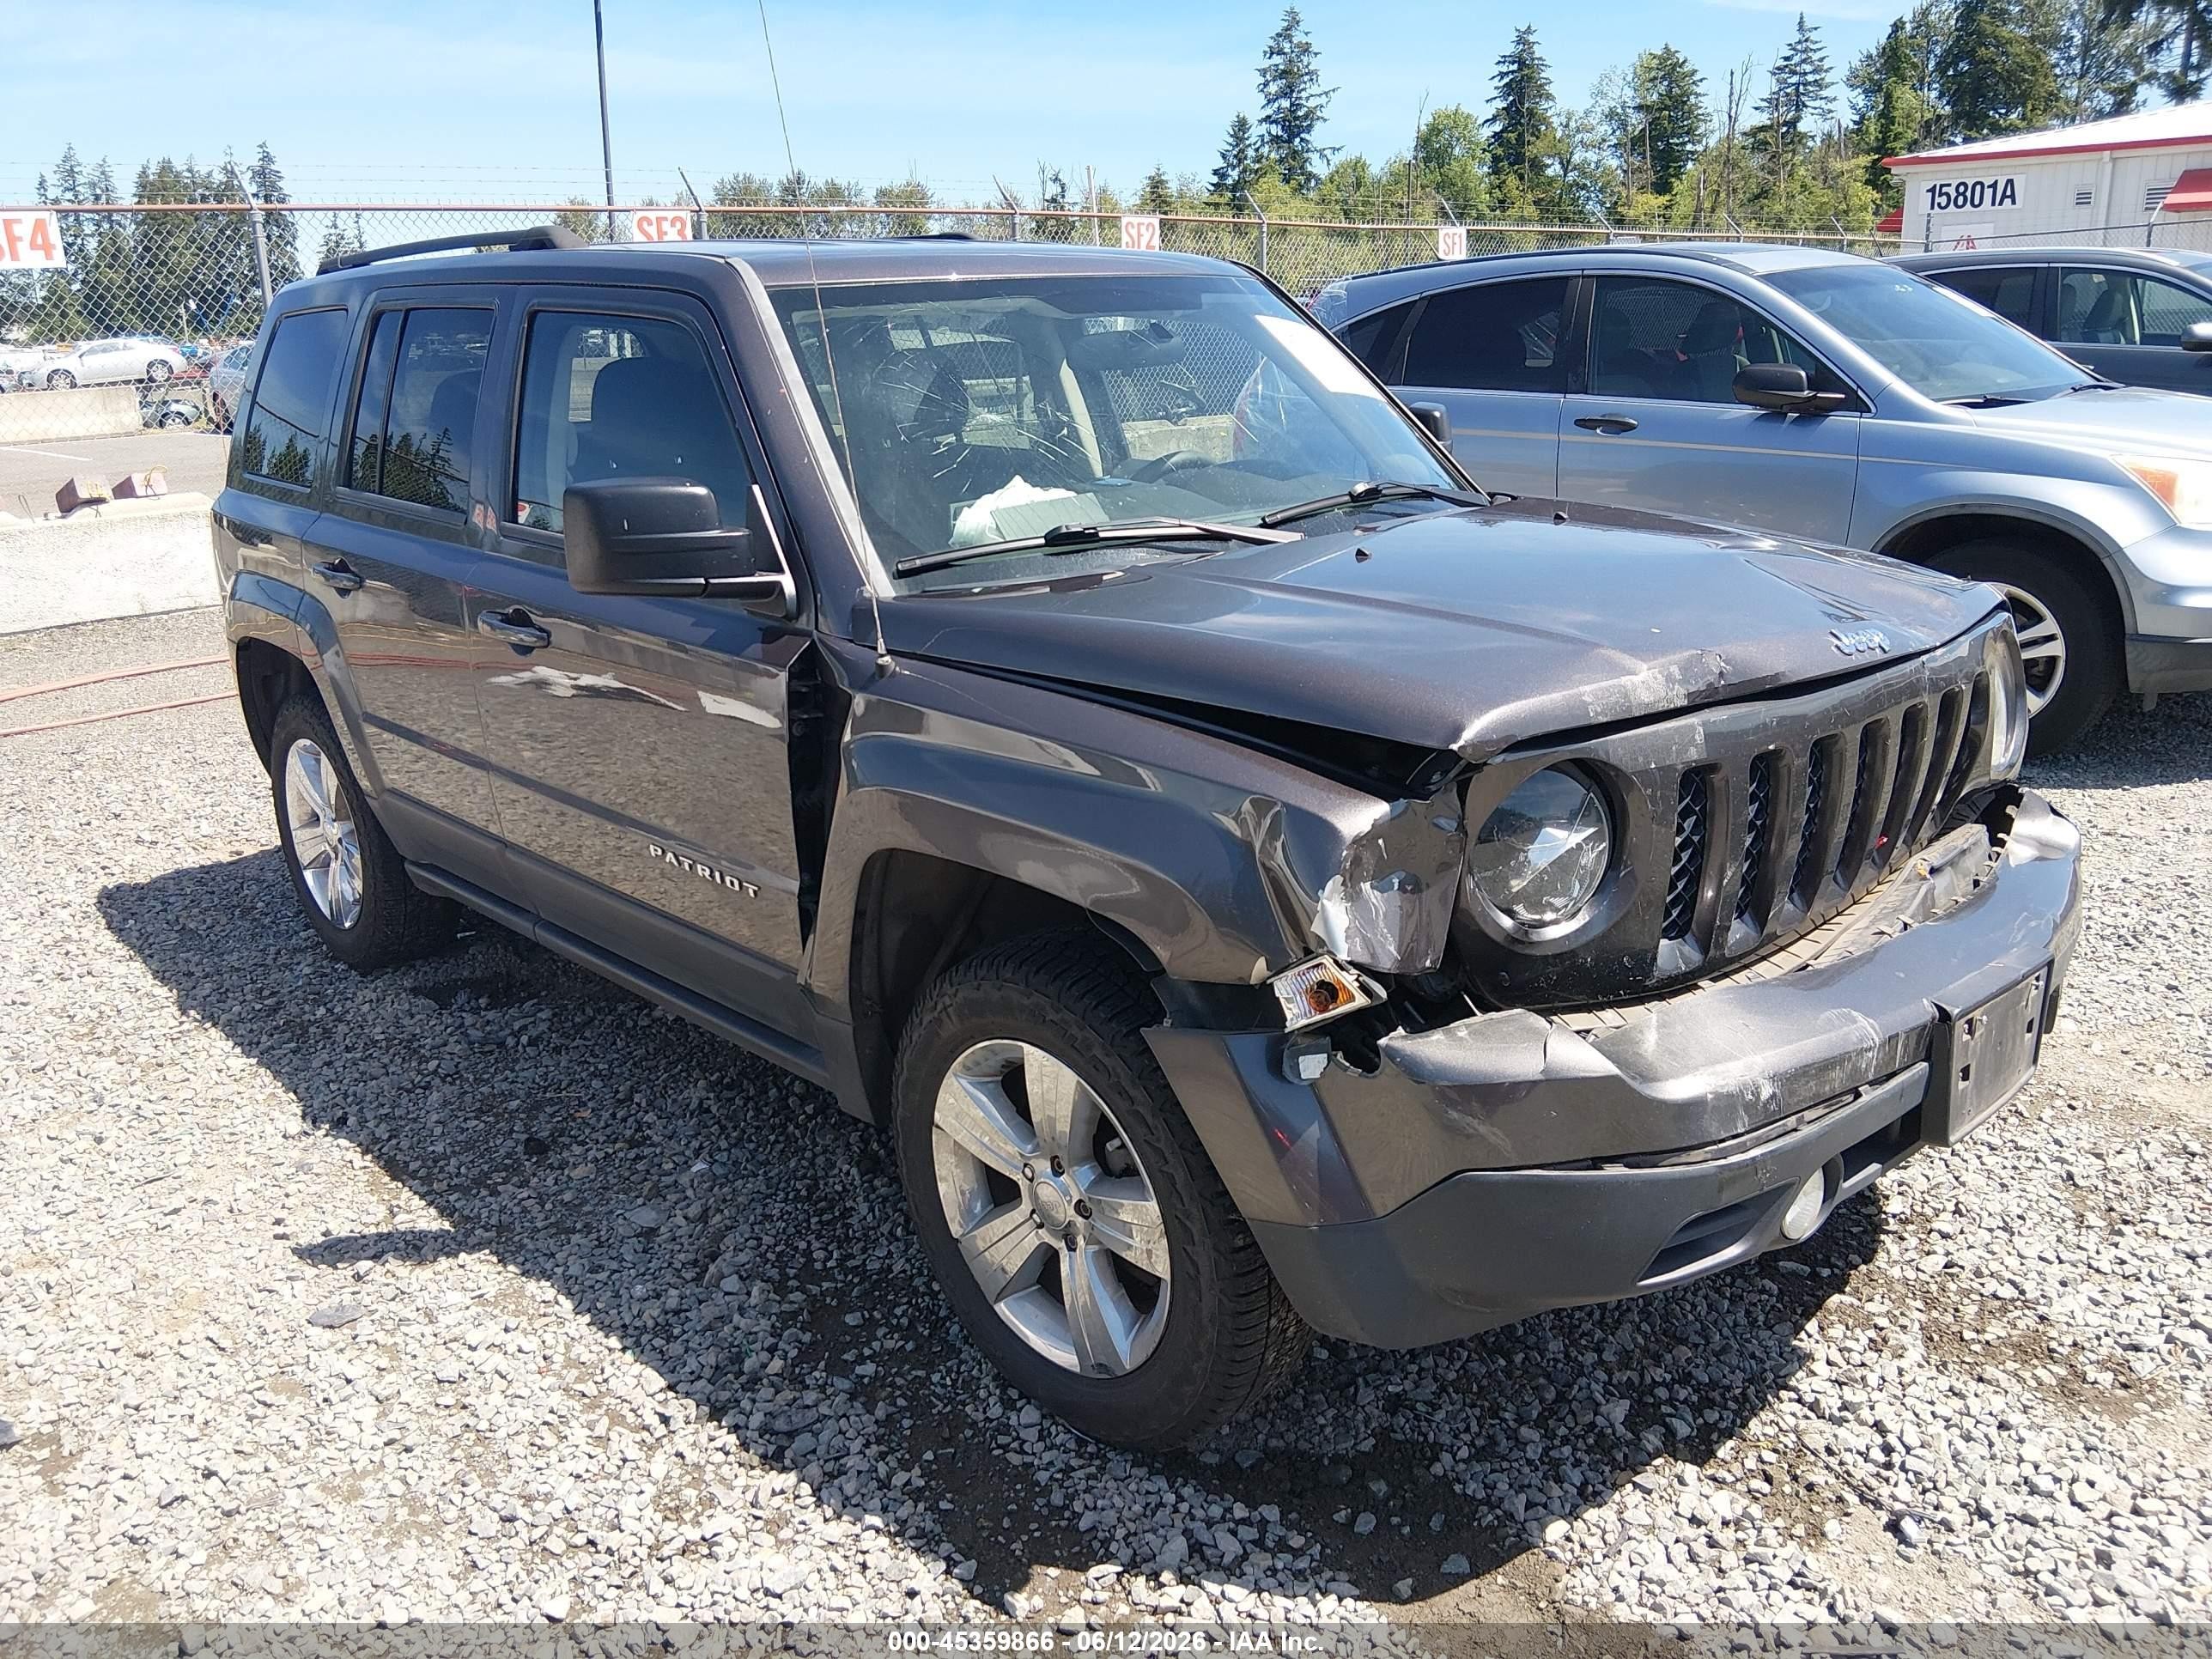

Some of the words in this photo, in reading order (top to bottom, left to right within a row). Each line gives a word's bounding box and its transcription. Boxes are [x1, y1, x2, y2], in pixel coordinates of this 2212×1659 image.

[1925, 178, 2017, 210] 15801A
[0, 217, 57, 262] F4
[1125, 221, 1156, 250] SF2
[1443, 232, 1462, 257] SF1
[1829, 629, 1891, 656] Jeep
[649, 843, 761, 898] PATRIOT
